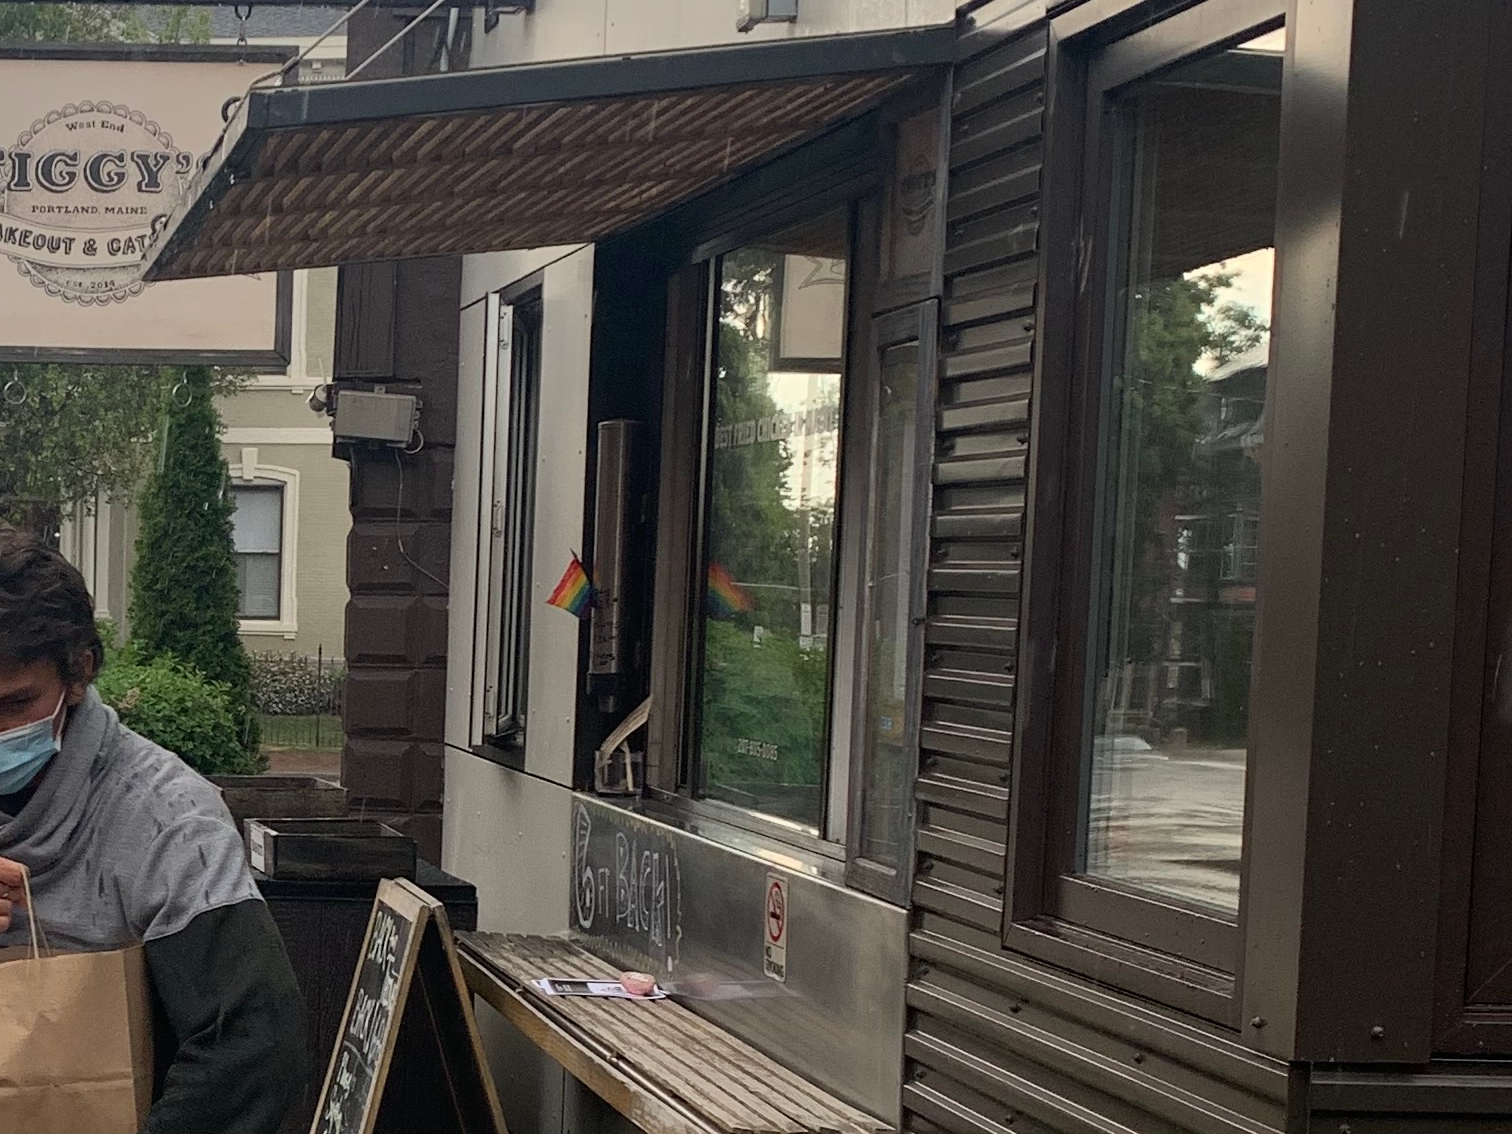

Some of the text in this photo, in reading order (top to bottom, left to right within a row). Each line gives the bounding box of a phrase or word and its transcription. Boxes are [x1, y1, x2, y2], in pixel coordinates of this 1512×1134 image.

[65, 120, 125, 133] West End
[104, 206, 148, 215] MAINE
[82, 238, 98, 256] &
